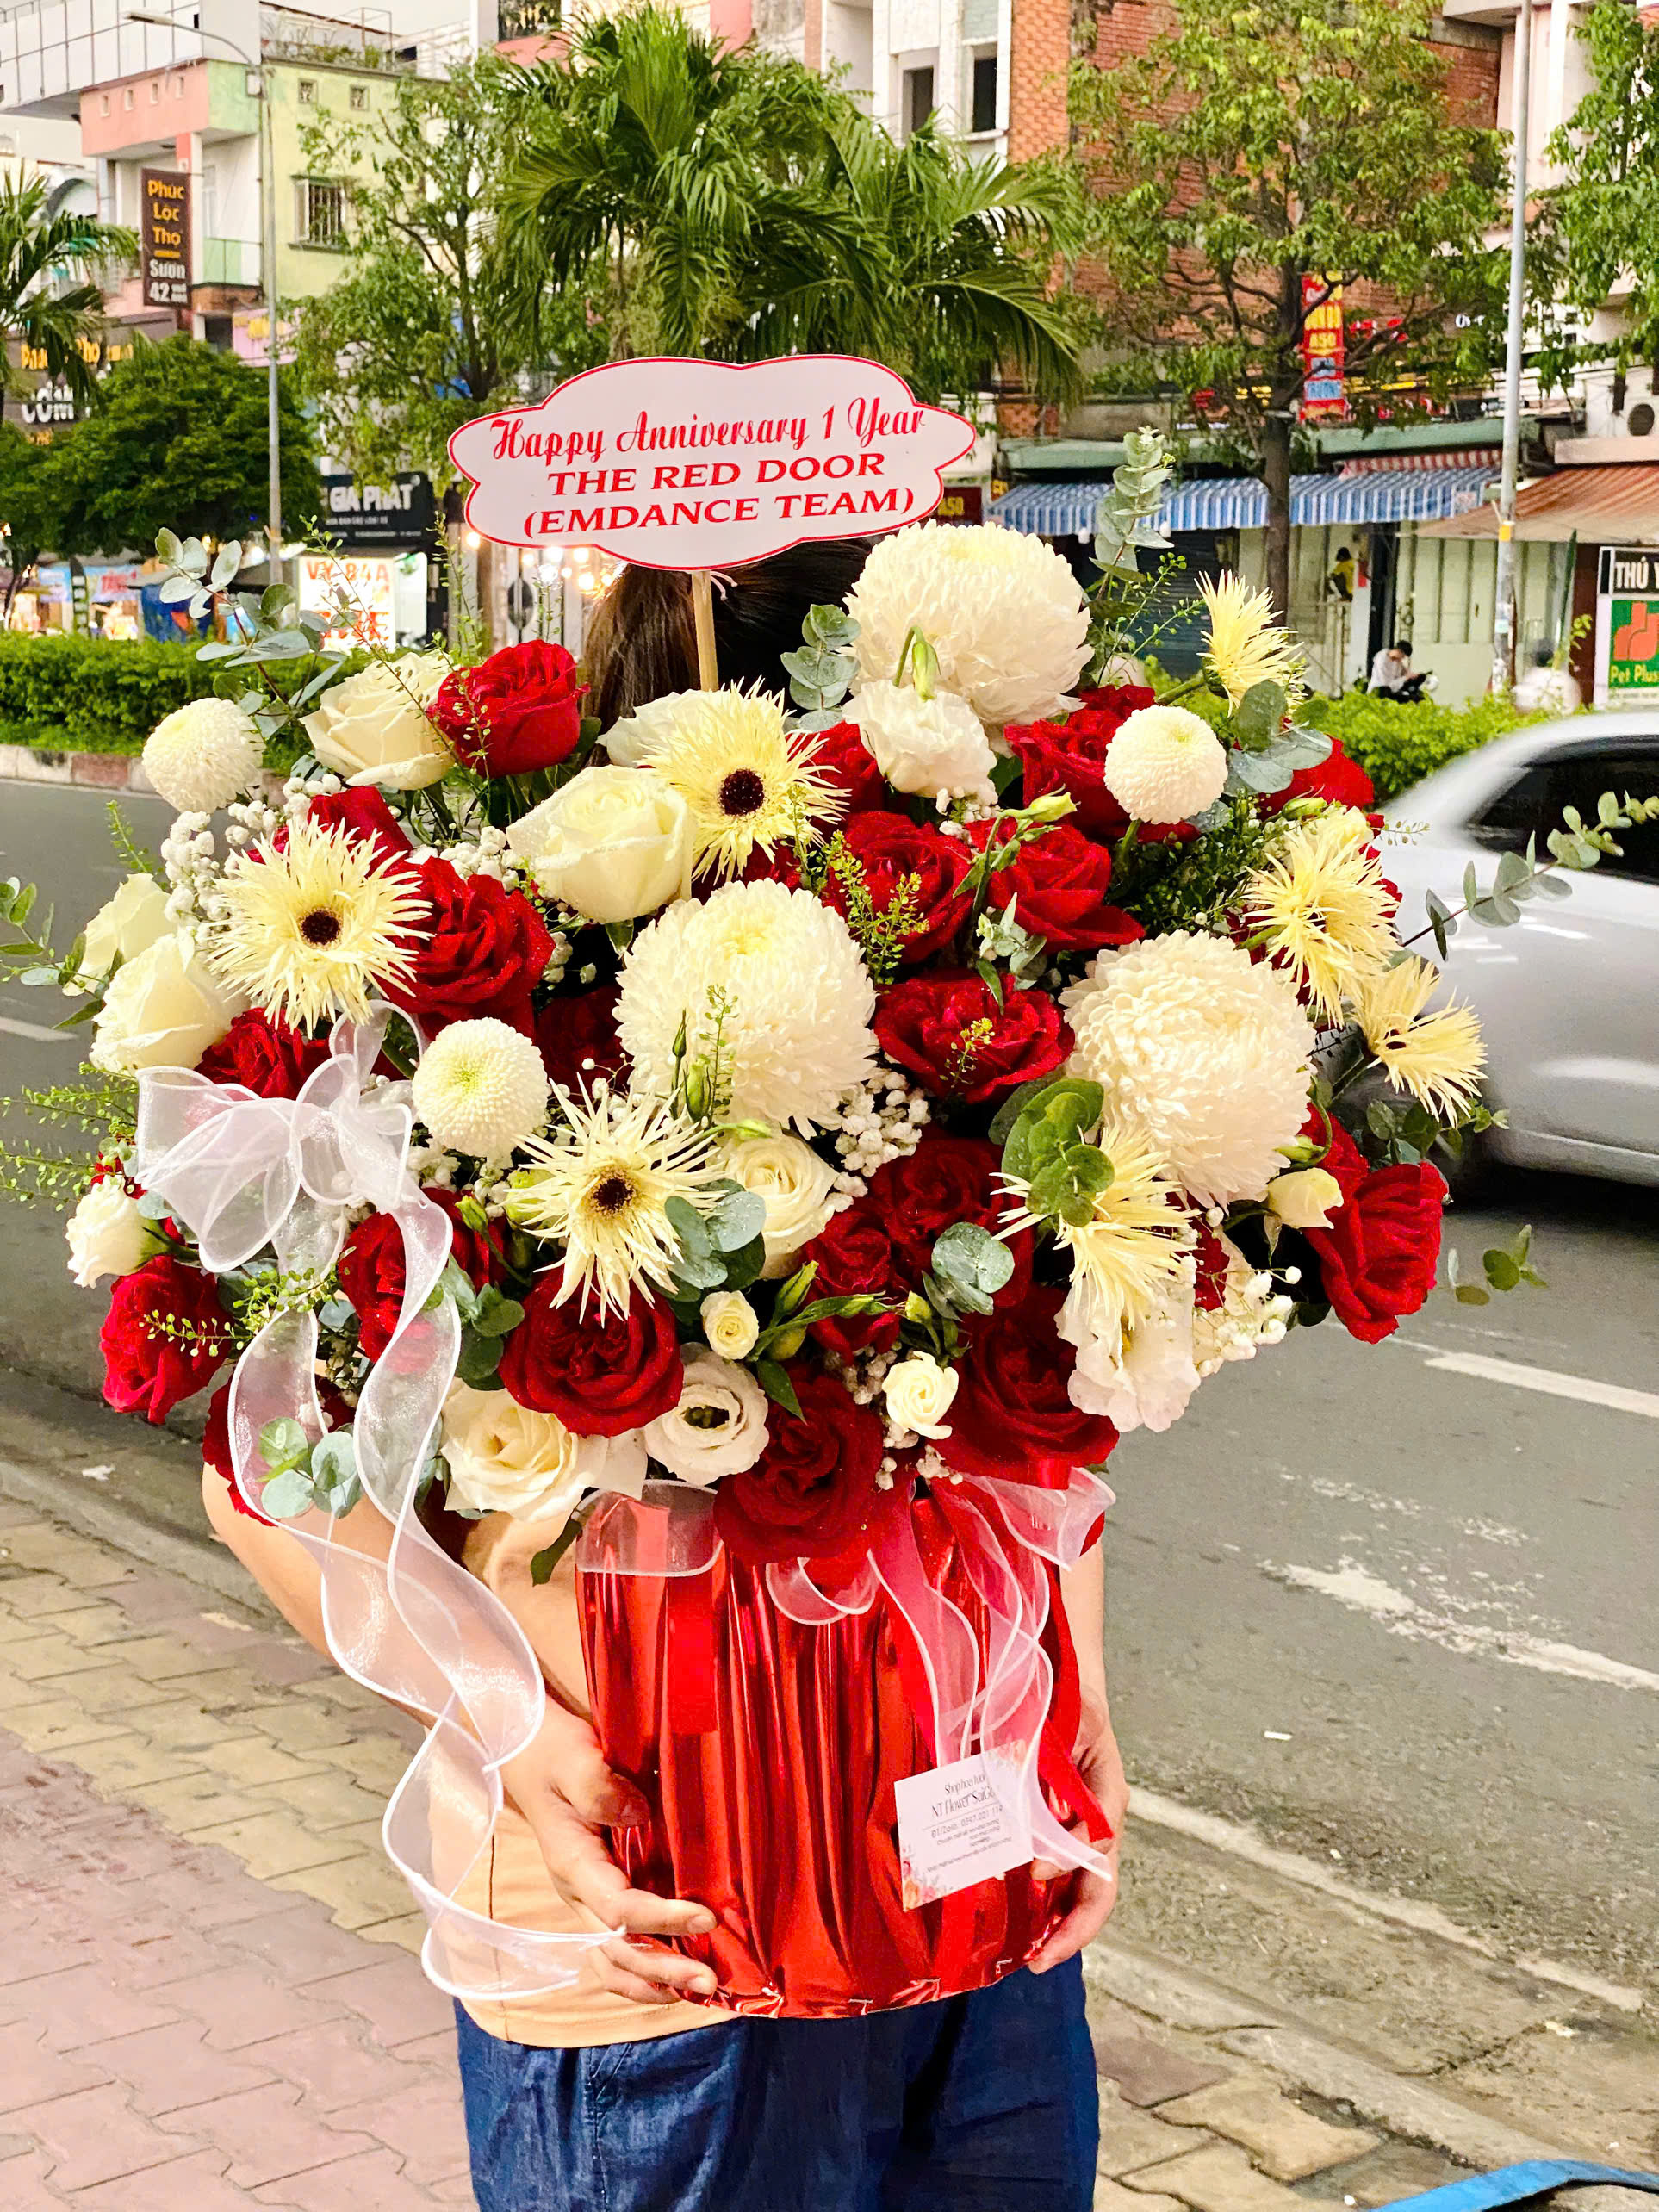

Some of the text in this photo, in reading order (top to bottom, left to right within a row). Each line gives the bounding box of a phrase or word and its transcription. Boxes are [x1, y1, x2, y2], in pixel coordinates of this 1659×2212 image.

[490, 397, 926, 466] Happy Anniversary 1 Year
[546, 453, 885, 495] THE RED DOOR
[524, 488, 914, 538] (EMDANCE TEAM)
[1615, 556, 1649, 589] THÚ
[1610, 665, 1630, 683] Pet
